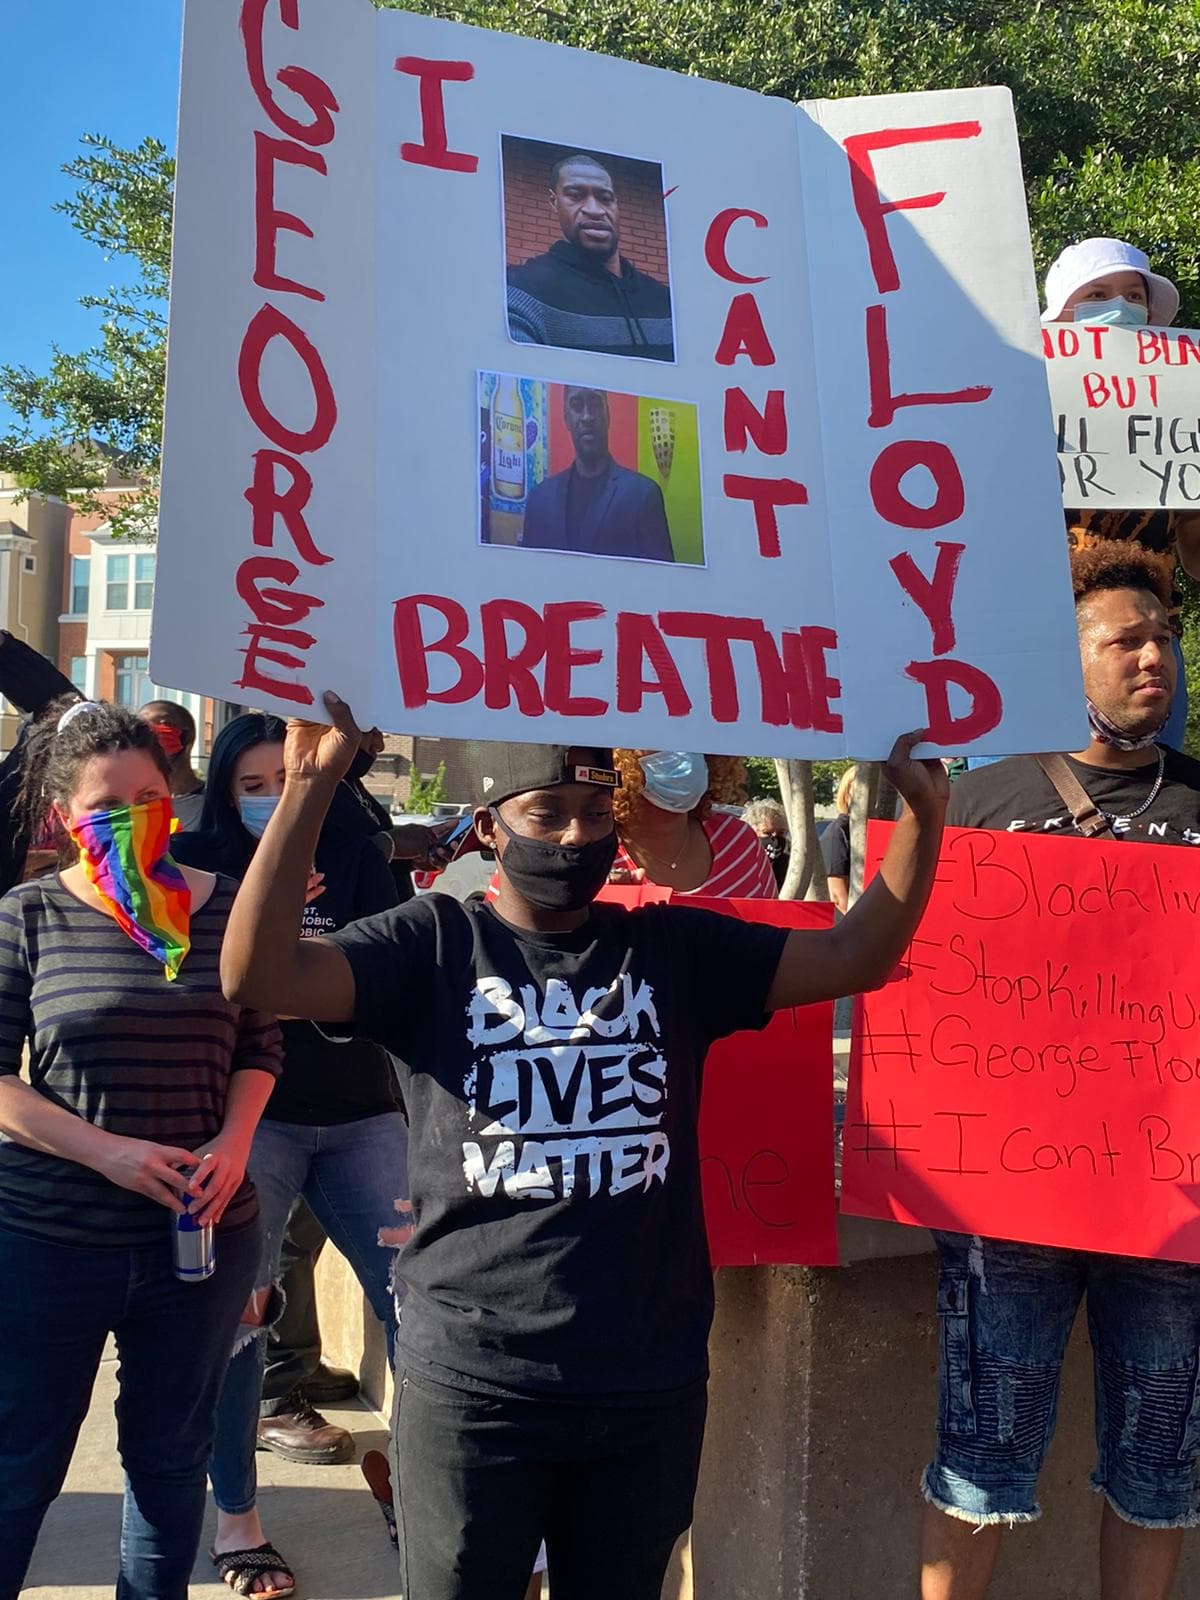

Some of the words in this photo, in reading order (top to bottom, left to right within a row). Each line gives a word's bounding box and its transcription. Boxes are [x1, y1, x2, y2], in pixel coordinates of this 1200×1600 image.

[394, 57, 479, 173] I
[233, 0, 340, 705] GEORGE
[704, 208, 808, 558] CANT
[1083, 372, 1163, 409] BUT
[1136, 329, 1200, 366] BLA
[843, 120, 1004, 746] FLOYD
[1128, 414, 1200, 455] FIG
[393, 594, 843, 733] BREATHE
[465, 972, 661, 1050] BLACK
[898, 934, 1200, 1046] #StopKillingU
[468, 1044, 667, 1134] LIVES
[462, 1132, 670, 1199] MATTER
